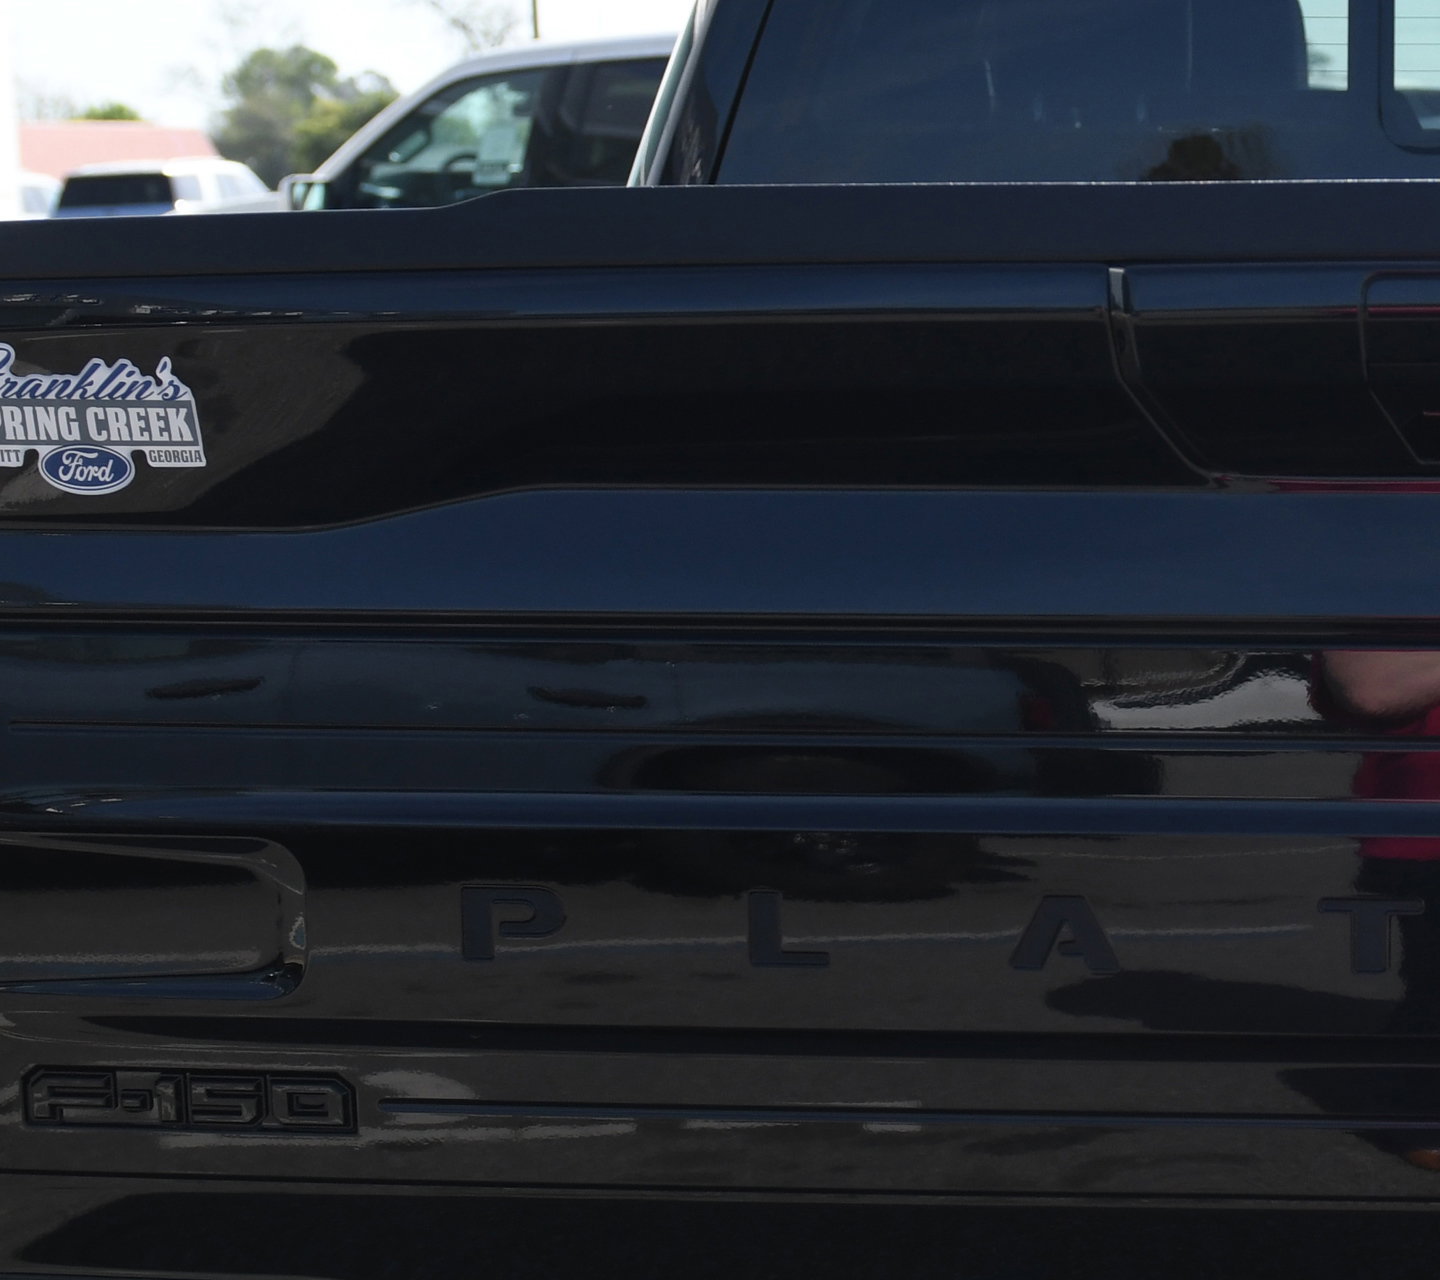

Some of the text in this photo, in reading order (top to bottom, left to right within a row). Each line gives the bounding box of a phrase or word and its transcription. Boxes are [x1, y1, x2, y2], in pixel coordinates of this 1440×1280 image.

[86, 406, 194, 442] CREEK
[58, 450, 115, 483] Ford
[148, 449, 203, 464] GEORGIA
[22, 1064, 358, 1134] F-150
